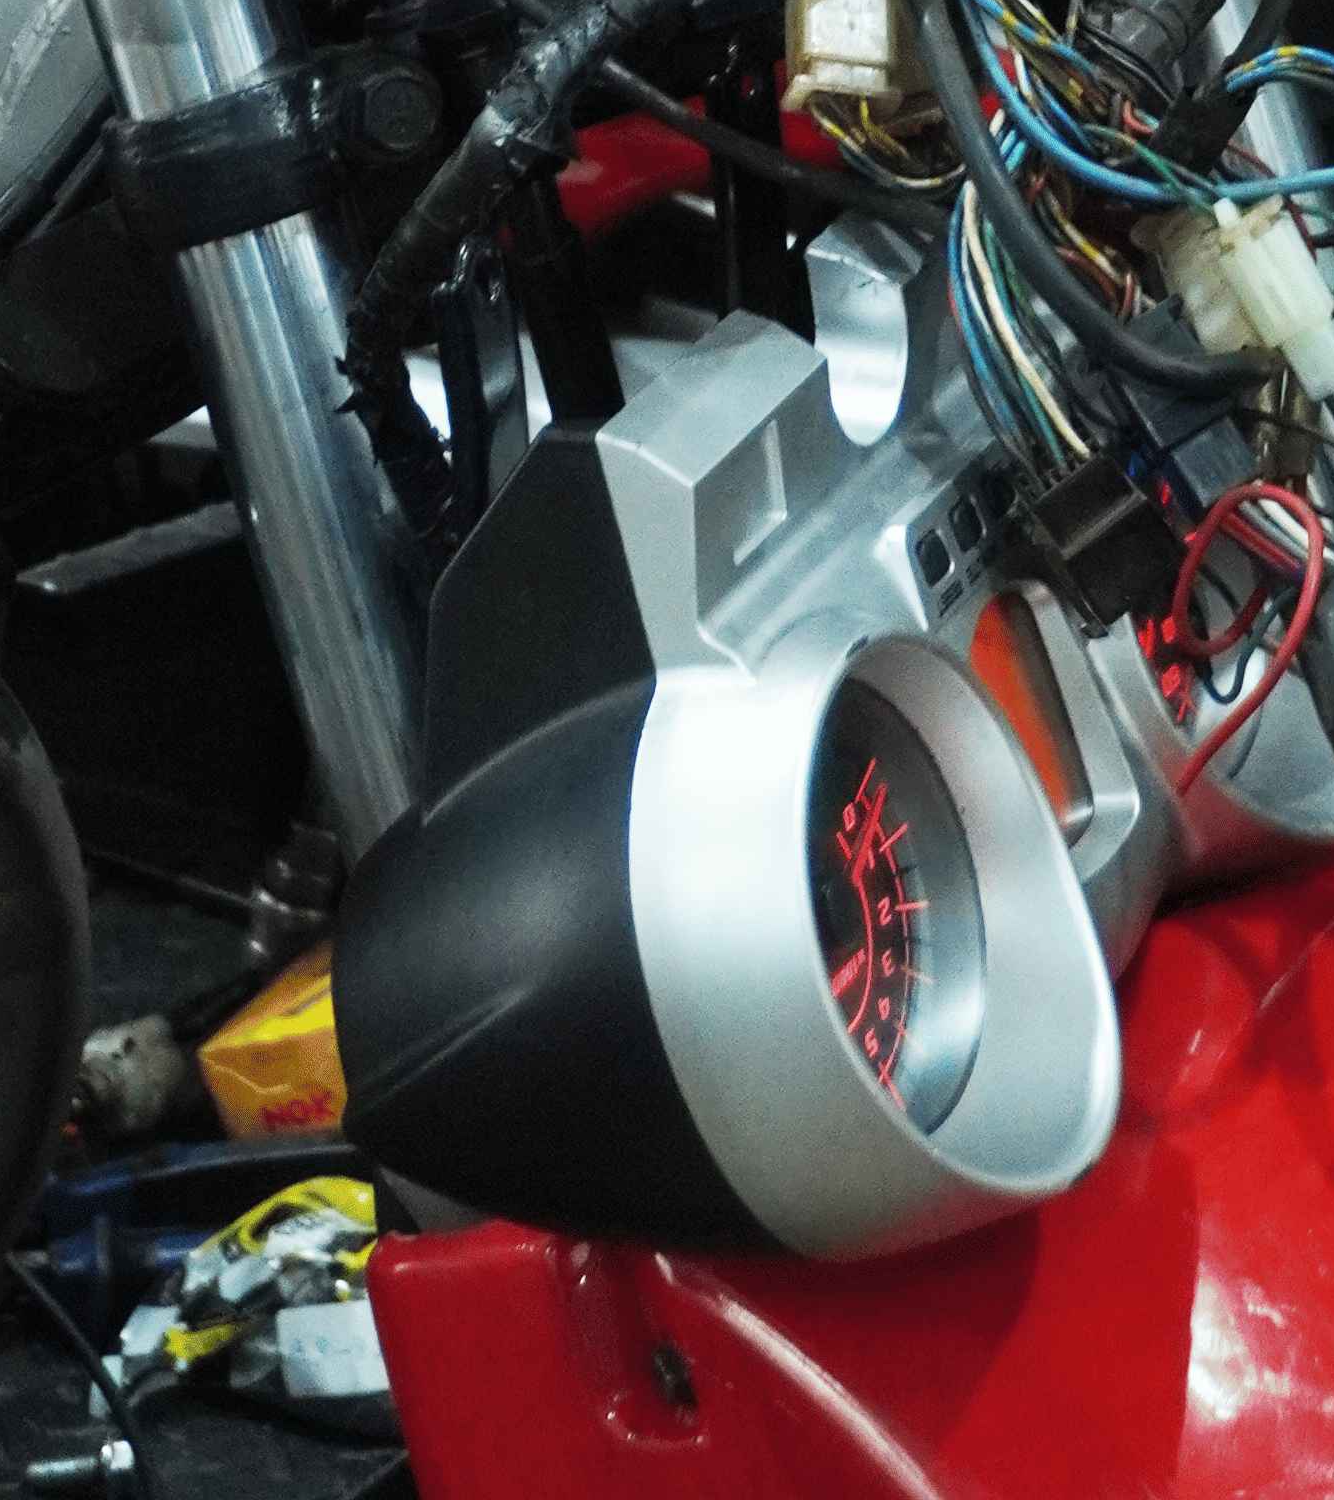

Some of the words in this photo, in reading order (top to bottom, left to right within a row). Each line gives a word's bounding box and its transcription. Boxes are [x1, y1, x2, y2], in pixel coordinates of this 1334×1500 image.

[877, 896, 892, 926] 2
[880, 948, 896, 977] 3
[877, 996, 891, 1021] 4
[864, 1026, 880, 1059] 5
